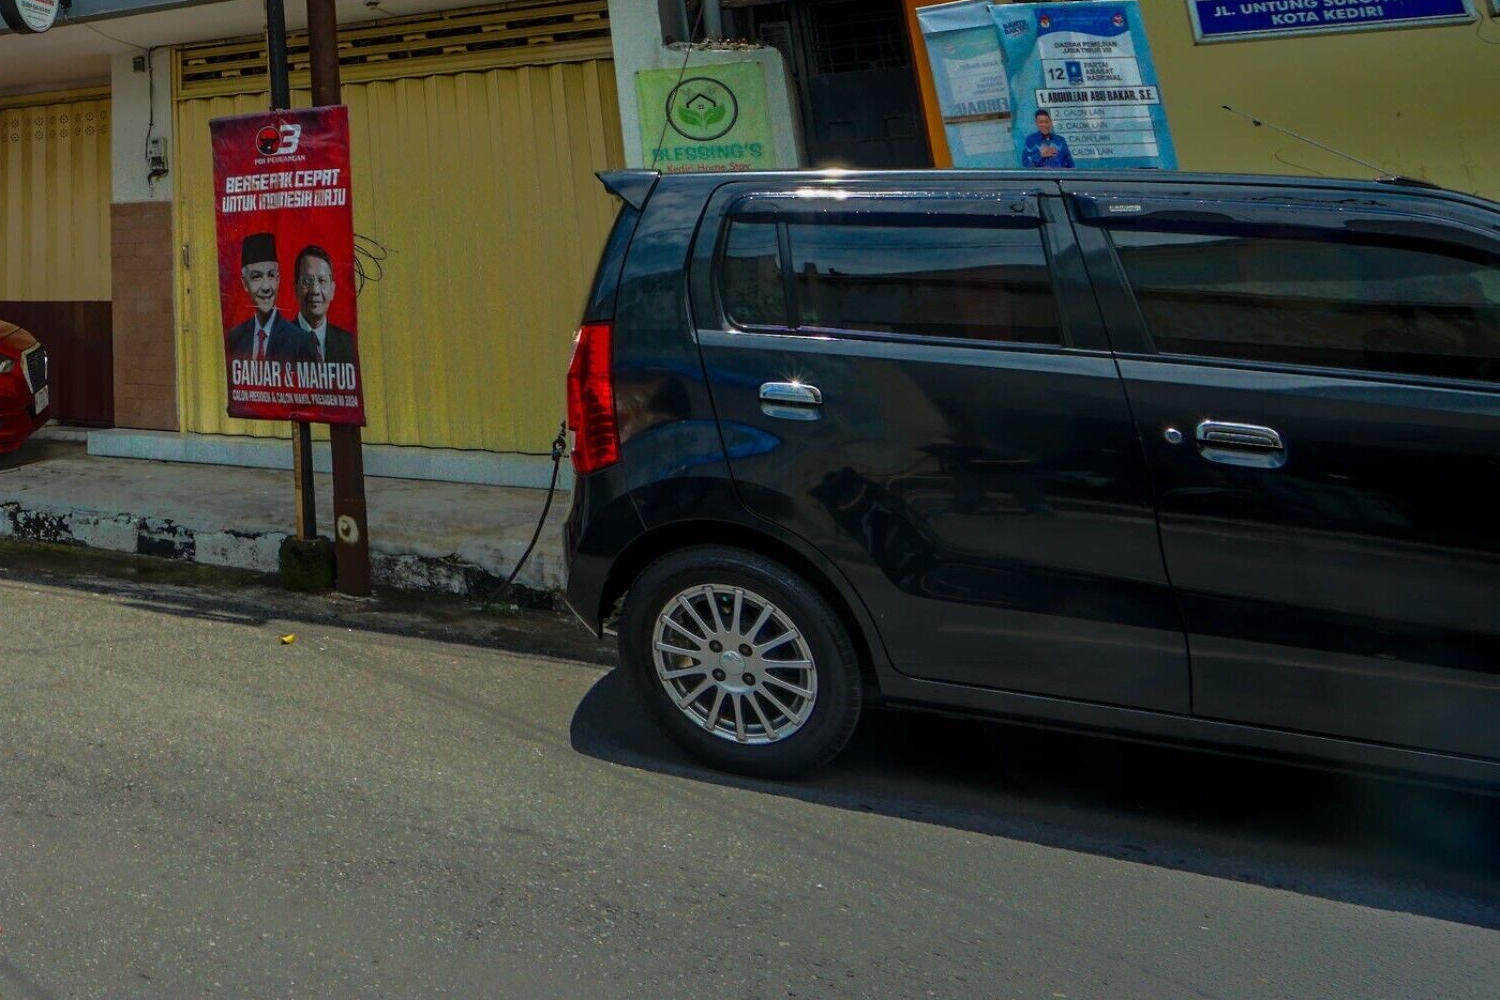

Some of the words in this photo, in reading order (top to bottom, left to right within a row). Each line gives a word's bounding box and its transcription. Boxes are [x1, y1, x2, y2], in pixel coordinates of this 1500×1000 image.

[1214, 4, 1236, 17] JL.
[1271, 11, 1320, 26] KOTA
[1324, 6, 1384, 22] KEDIRI
[1048, 67, 1065, 81] 12
[1090, 90, 1106, 102] ABU
[1139, 89, 1156, 101] S.E.
[1063, 109, 1088, 117] CALON
[1089, 108, 1105, 116] LAIN
[1066, 122, 1090, 130] CALON
[1069, 135, 1093, 143] CALON
[651, 142, 764, 161] BLESSING'S
[1072, 148, 1096, 156] CALON
[697, 163, 725, 172] Home
[729, 162, 750, 172] Stay
[225, 171, 293, 194] BERGERAK
[295, 168, 341, 187] CEPAT
[222, 194, 257, 213] UNTUK
[259, 190, 313, 210] INDONESIA
[314, 188, 347, 207] MAJU
[232, 359, 281, 387] GANJAR
[284, 361, 295, 388] &
[297, 361, 357, 390] MAHFUD
[232, 389, 246, 401] CALON
[277, 391, 293, 404] CALON
[312, 393, 339, 406] PRESIDEN
[345, 394, 358, 407] 2024
